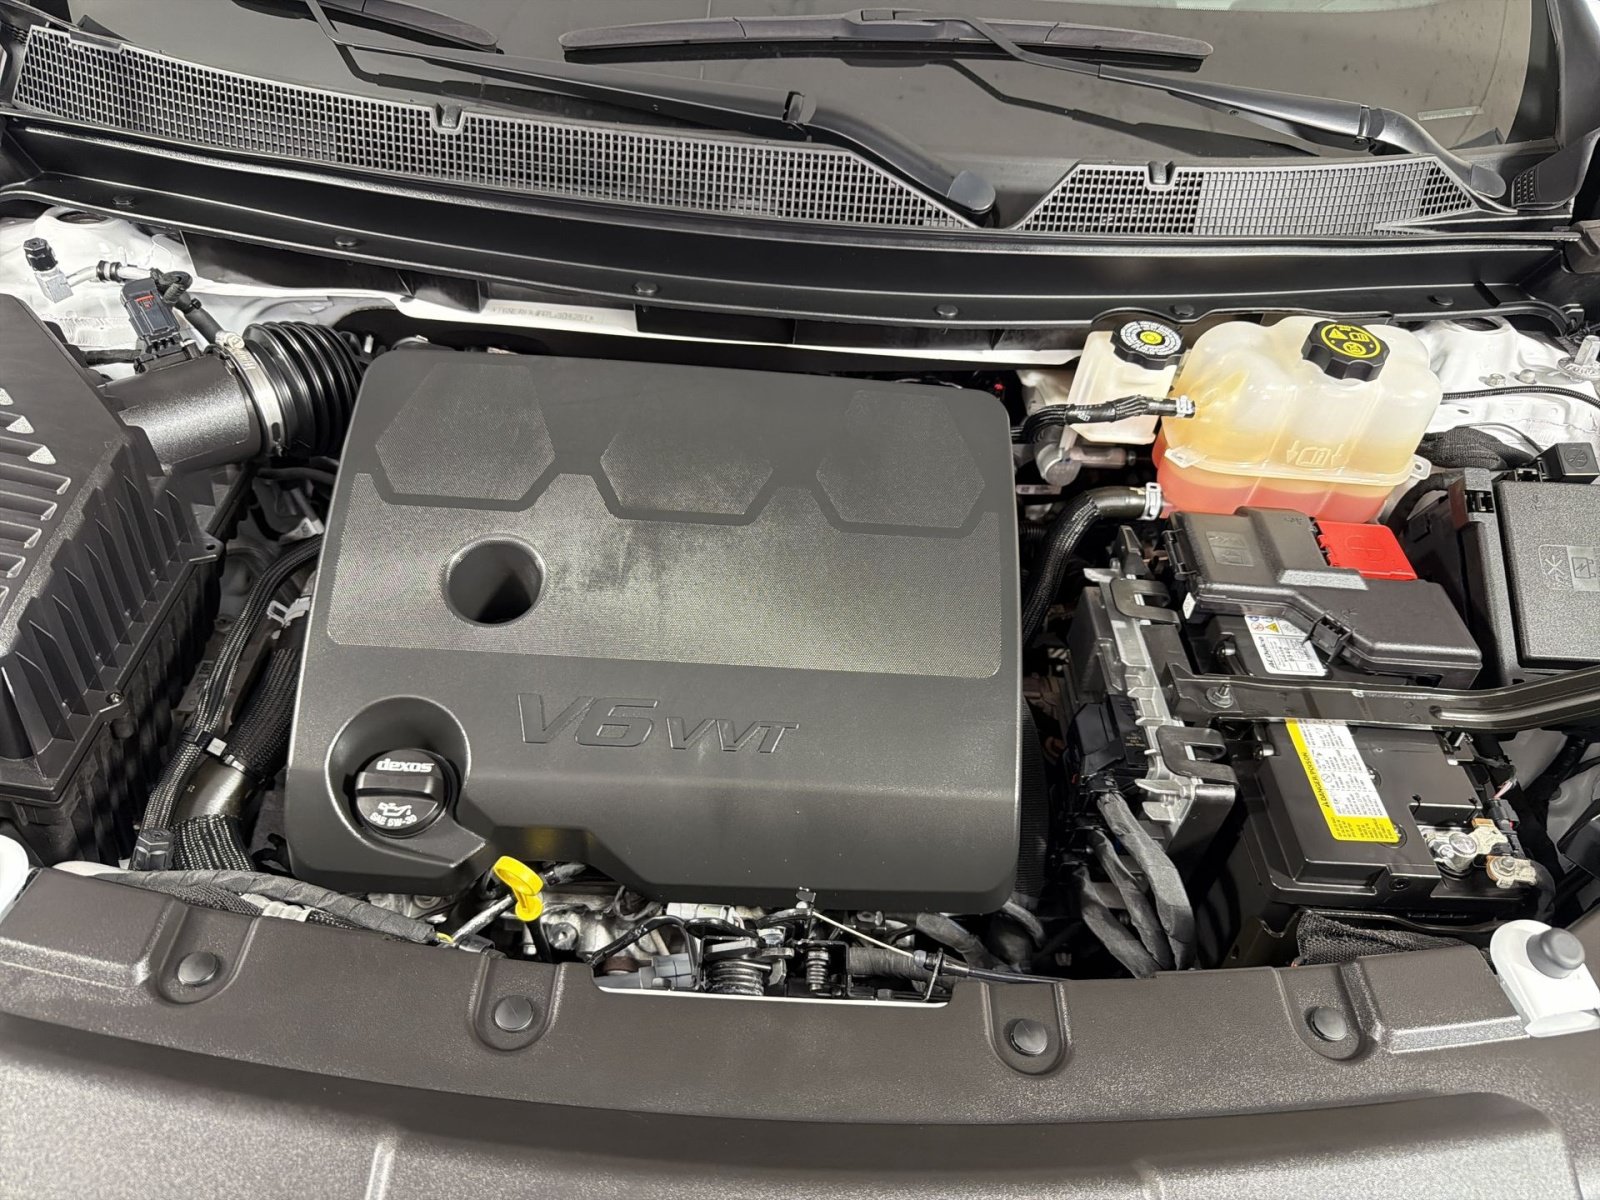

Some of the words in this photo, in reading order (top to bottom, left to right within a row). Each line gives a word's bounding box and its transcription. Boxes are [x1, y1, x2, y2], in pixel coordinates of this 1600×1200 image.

[517, 692, 660, 748] V6
[666, 716, 800, 753] VVT
[376, 758, 435, 773] dexos
[370, 812, 388, 825] SAE
